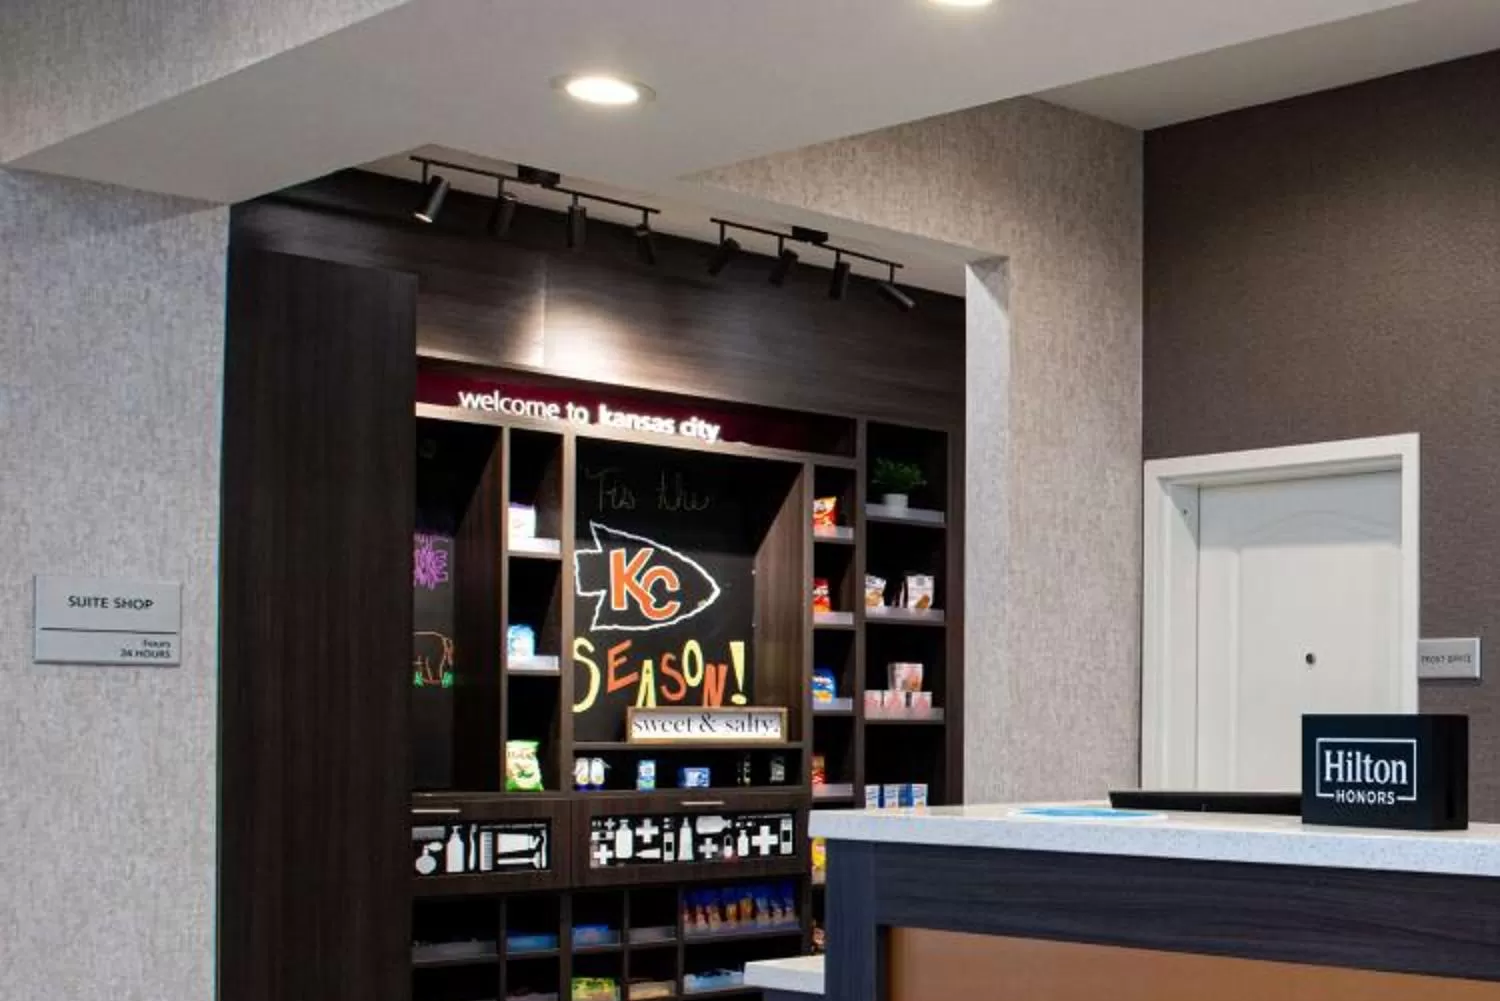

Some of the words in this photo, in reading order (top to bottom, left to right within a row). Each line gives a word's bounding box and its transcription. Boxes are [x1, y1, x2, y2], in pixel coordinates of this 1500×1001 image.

[458, 390, 561, 421] welcome
[565, 402, 590, 424] to
[598, 404, 676, 434] kansas
[680, 416, 721, 443] city
[608, 547, 681, 621] KC
[68, 595, 109, 609] SUITE
[113, 597, 155, 611] SHOP
[572, 637, 748, 713] SEASON!
[634, 716, 694, 733] sweet
[698, 712, 717, 733] &
[1323, 749, 1409, 785] Hilton
[1335, 789, 1396, 805] HONORS
